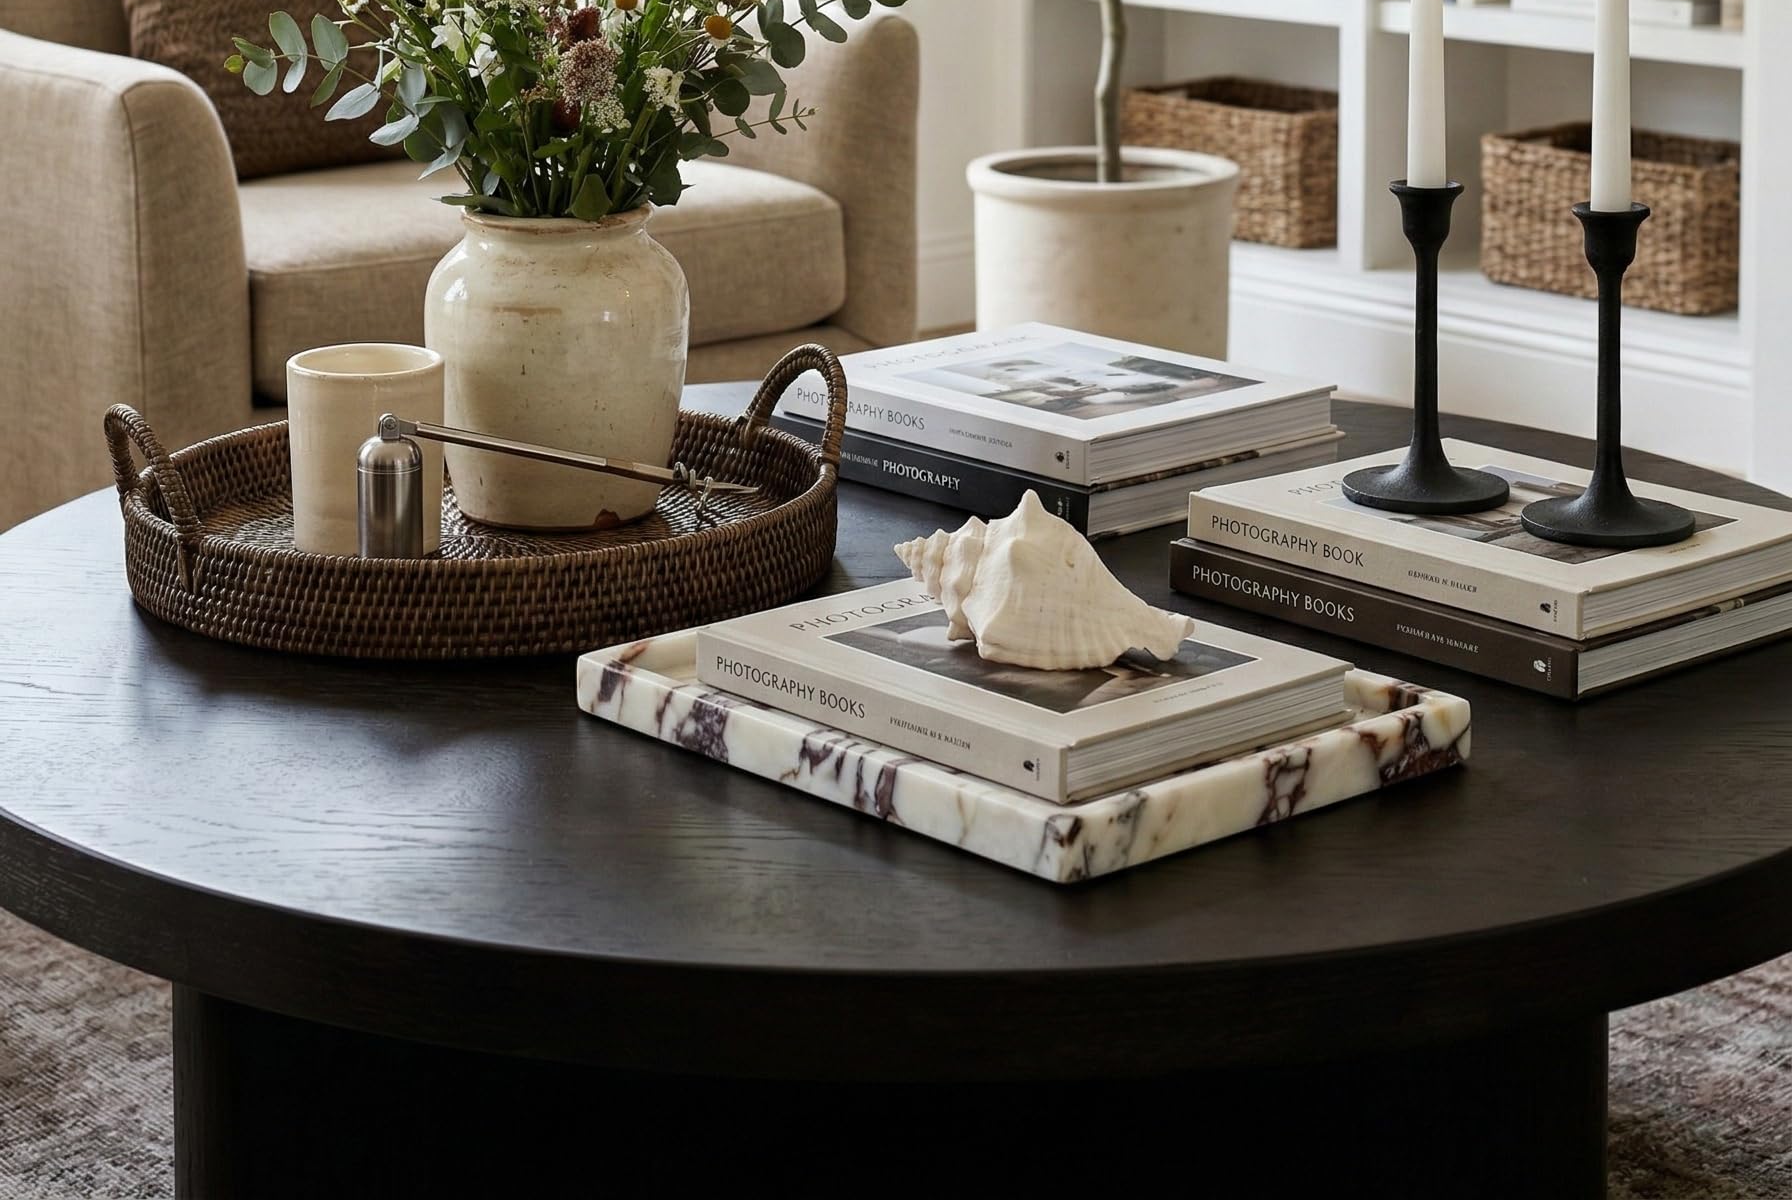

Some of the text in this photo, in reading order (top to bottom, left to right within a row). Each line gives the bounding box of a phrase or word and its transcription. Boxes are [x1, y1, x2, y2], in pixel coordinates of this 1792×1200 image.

[797, 387, 925, 430] PHOTRAPHY BOOKS
[882, 459, 960, 491] PHOTOGRAPHY
[1211, 515, 1364, 567] PHOTOGRAPHY BOOK
[789, 593, 935, 632] PHOTOGRA
[1192, 565, 1355, 622] PHOTOGRAPHY BOOKS
[716, 656, 865, 719] PHOTOGRAPHY BOOKS
